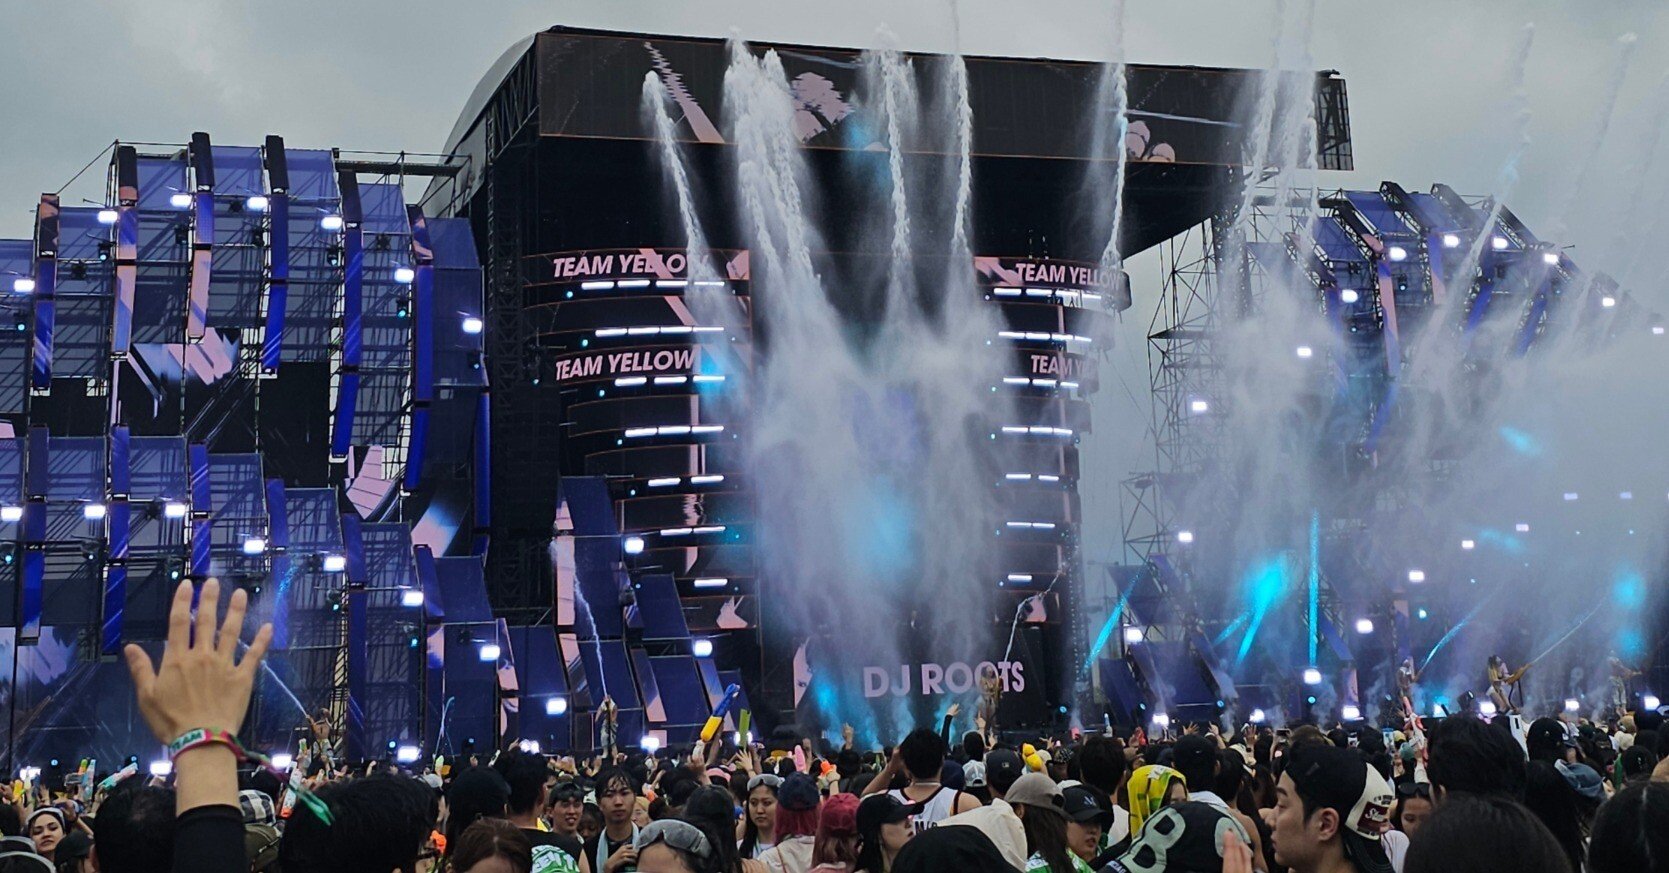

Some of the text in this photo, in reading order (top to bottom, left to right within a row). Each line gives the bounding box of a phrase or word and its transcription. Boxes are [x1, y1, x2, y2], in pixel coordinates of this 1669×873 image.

[553, 252, 709, 278] TEAM YELO
[1016, 263, 1066, 283] TEAM
[556, 350, 696, 380] TEAM YELLOW
[1031, 355, 1073, 376] TEAM
[863, 661, 1025, 698] DJ ROOTS
